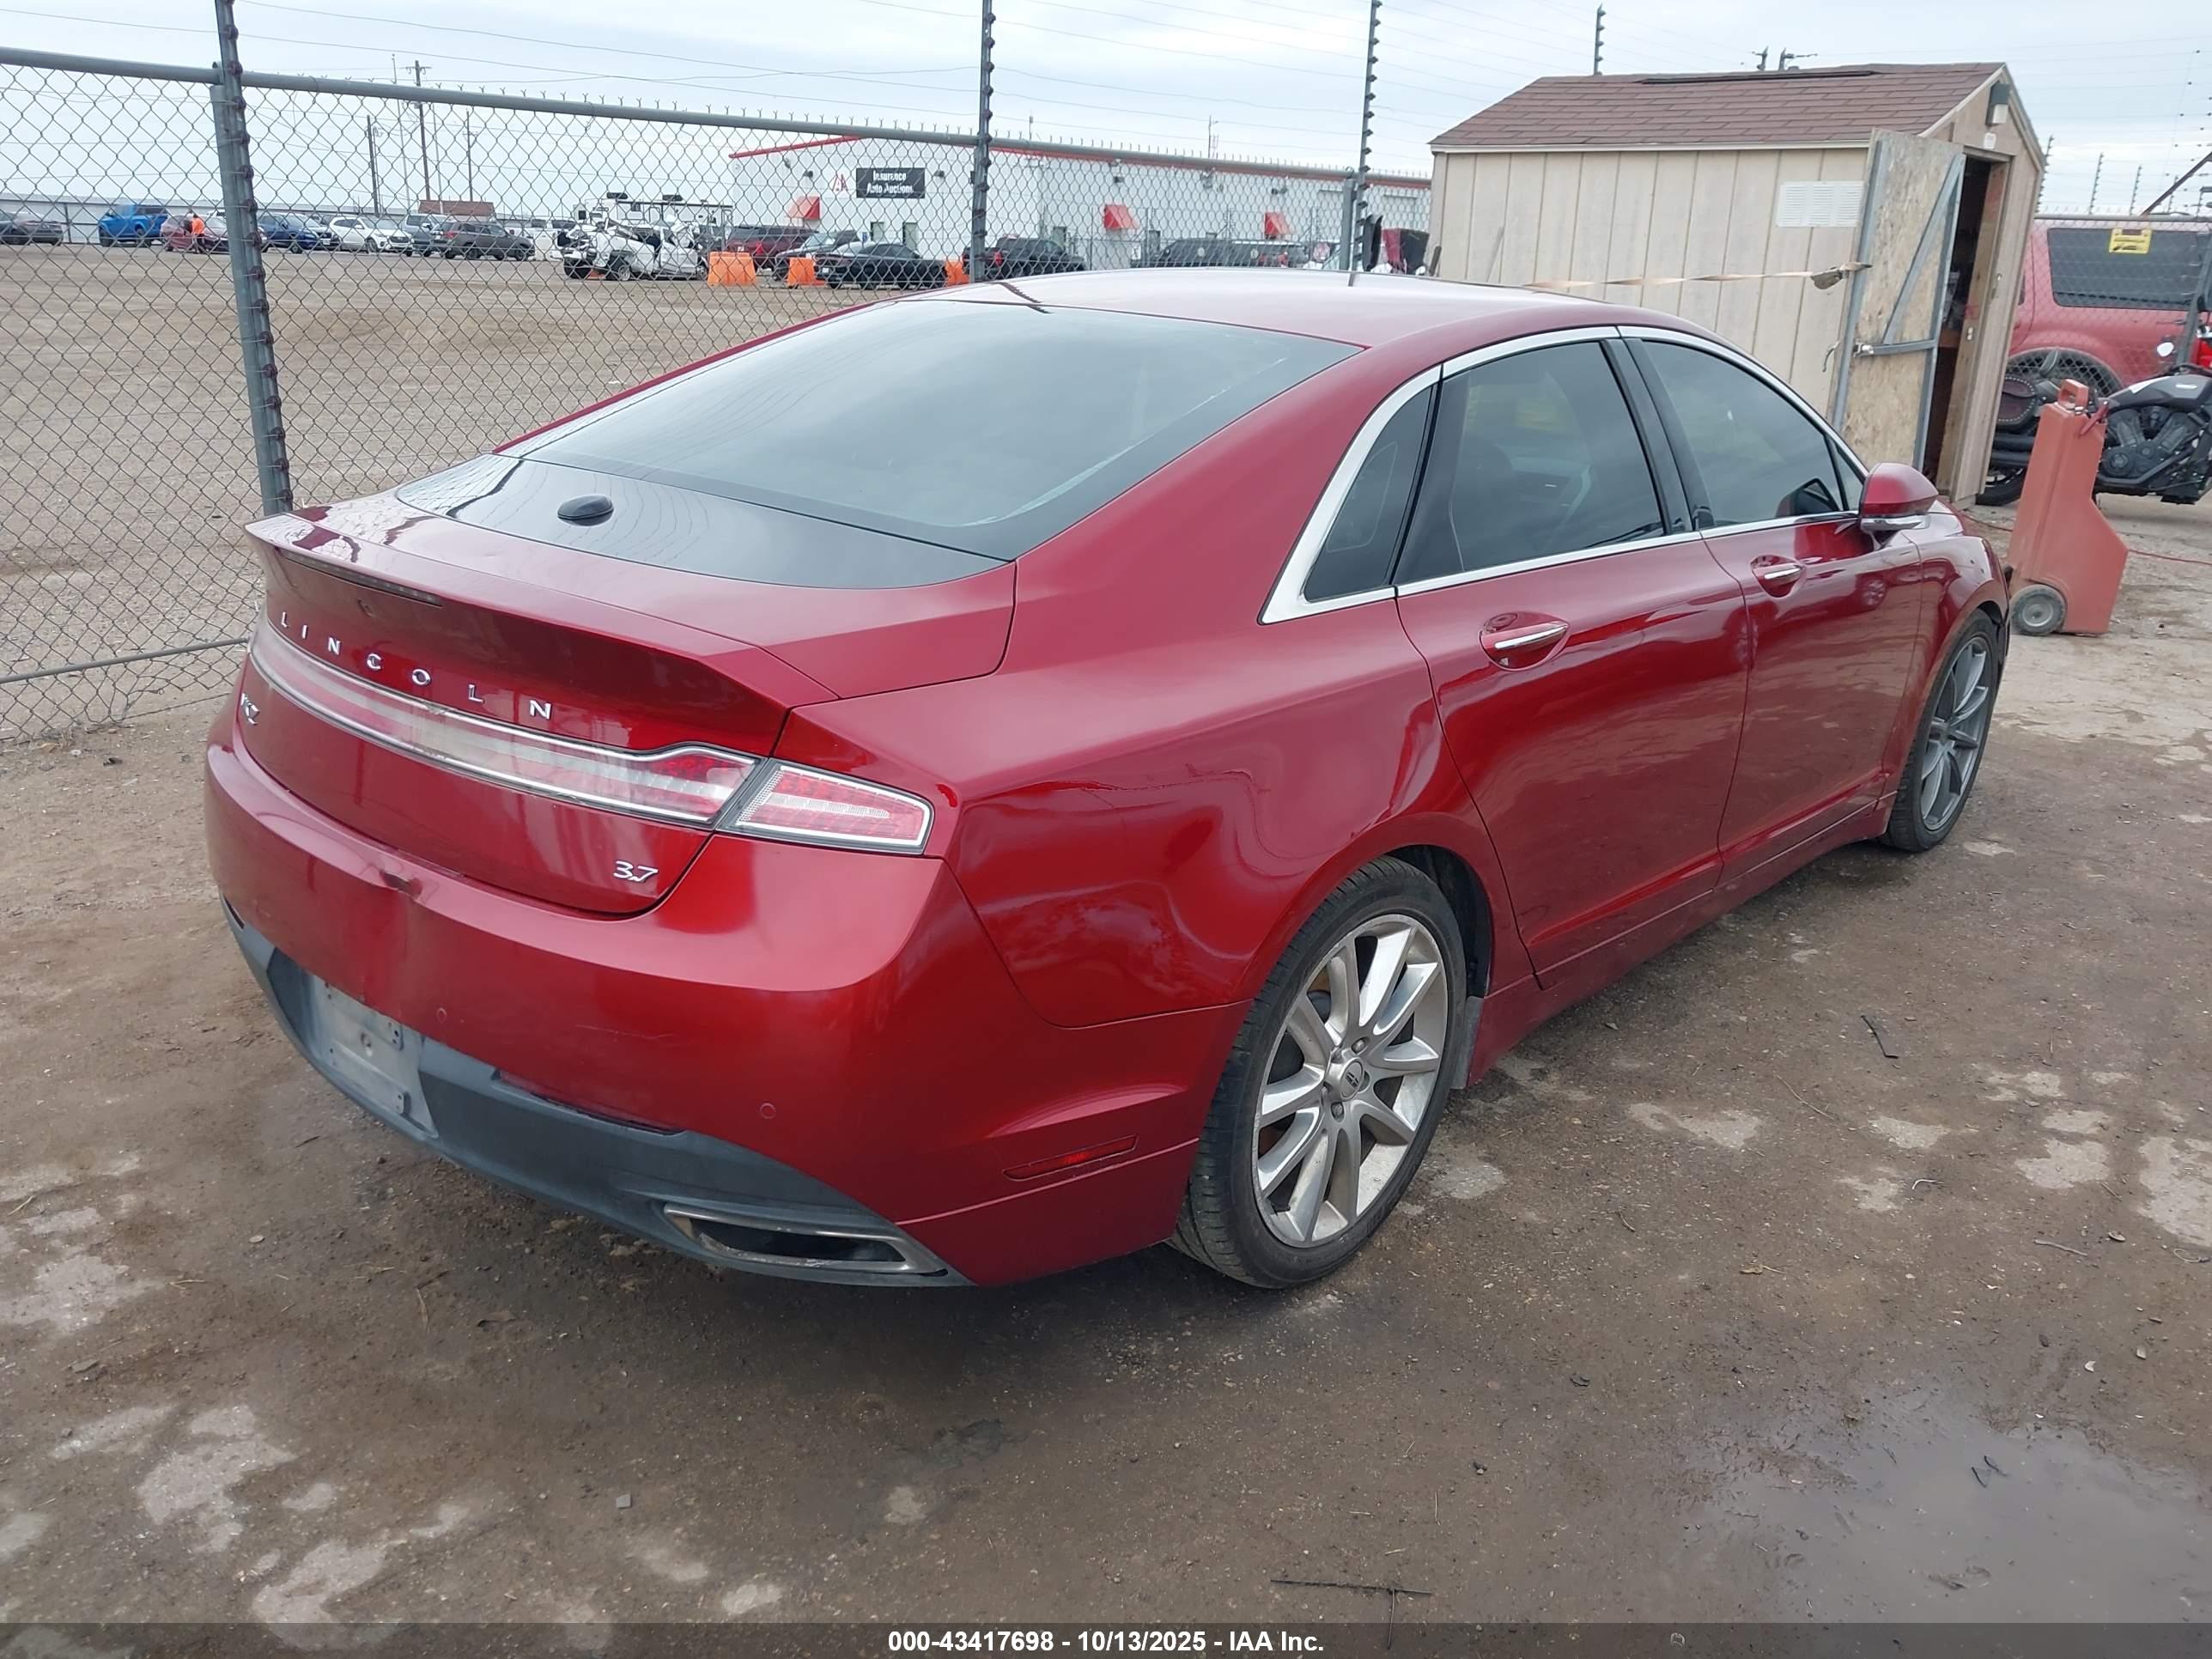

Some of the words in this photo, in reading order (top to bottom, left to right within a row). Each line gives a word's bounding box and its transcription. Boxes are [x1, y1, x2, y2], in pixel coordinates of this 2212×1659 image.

[872, 170, 907, 181] Insurance
[866, 182, 883, 193] Auto
[884, 182, 915, 193] Auctions
[281, 611, 552, 720] LINCOLN
